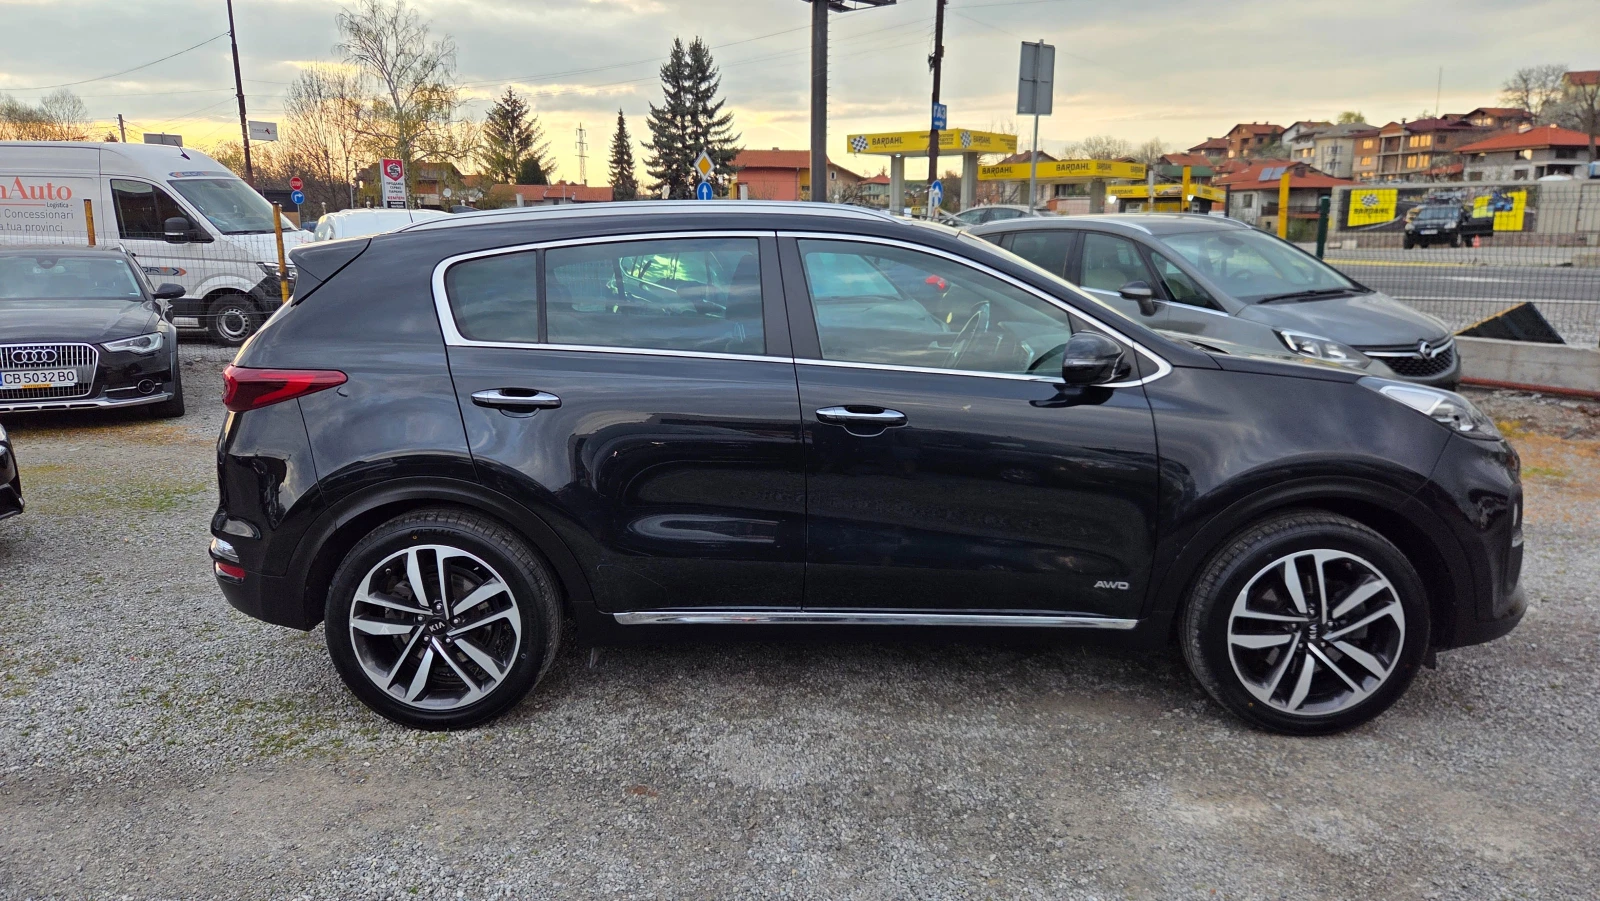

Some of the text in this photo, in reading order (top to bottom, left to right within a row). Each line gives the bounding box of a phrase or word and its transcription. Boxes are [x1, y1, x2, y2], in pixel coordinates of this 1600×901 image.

[933, 105, 946, 119] ГАЗ
[872, 137, 903, 148] BARDAHL
[982, 166, 1013, 176] BARDAHL
[1056, 163, 1091, 173] BARDAHL
[4, 208, 74, 219] Concessionari
[6, 222, 22, 231] tua
[25, 221, 63, 233] provinci
[4, 371, 75, 384] CB 5032 BO
[1093, 580, 1129, 590] AWD
[428, 621, 446, 632] KIA
[1309, 624, 1317, 639] KIA
